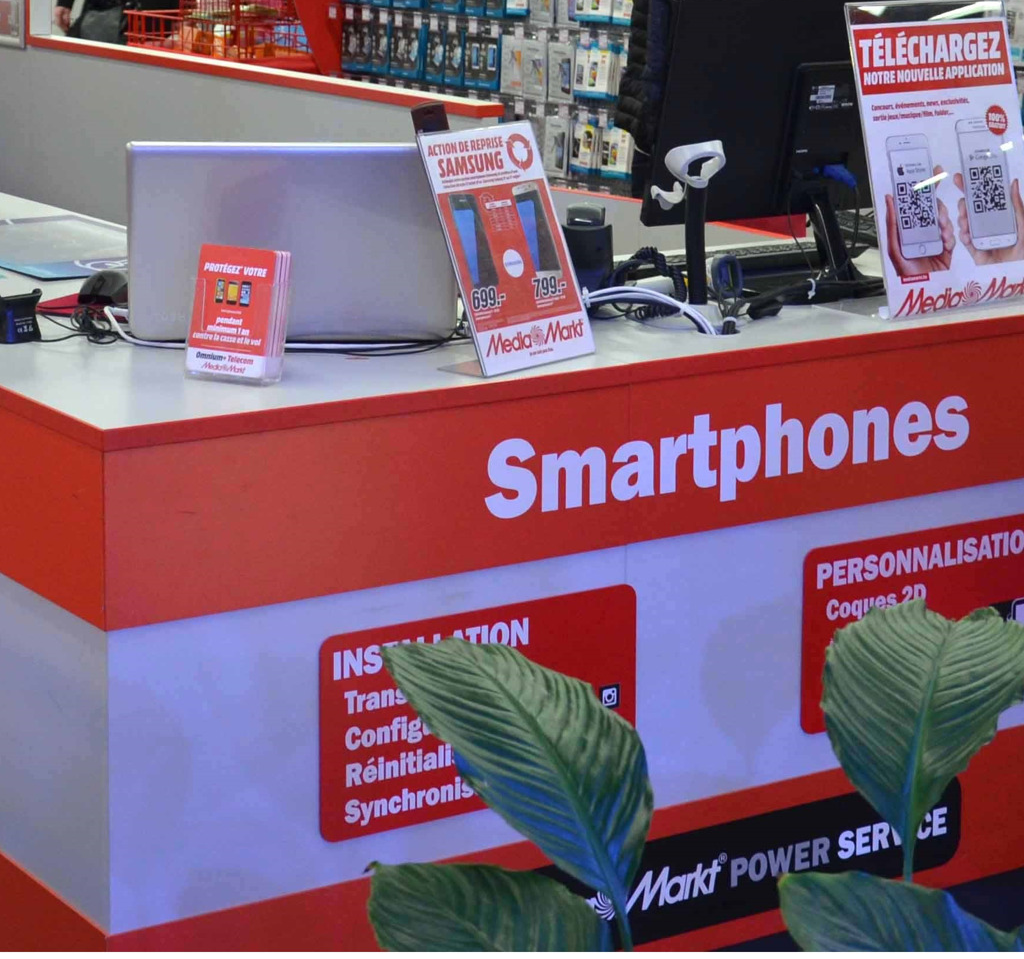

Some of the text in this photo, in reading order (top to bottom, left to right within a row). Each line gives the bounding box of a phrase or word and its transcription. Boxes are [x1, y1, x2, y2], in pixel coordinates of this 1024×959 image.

[859, 31, 1002, 68] TÉLÉCHARGEZ
[864, 63, 1005, 85] NOTRE NOUVELLE APPLICATION
[988, 112, 1005, 123] 100%
[428, 136, 504, 157] ACTION DE REPRISE
[438, 151, 504, 178] SAMSUNG
[243, 266, 268, 278] VOTRE
[216, 317, 243, 326] pendant
[192, 332, 213, 341] contre
[486, 319, 584, 357] Media Markt
[196, 351, 254, 365] Omnium+ Telecom
[485, 395, 971, 520] Smartphones
[816, 529, 1024, 589] PERSONNALISATIO
[826, 593, 897, 620] Coques
[333, 617, 529, 680] INSTION
[345, 744, 456, 788] Réinitiali
[626, 807, 948, 913] Markt POWER SERCE
